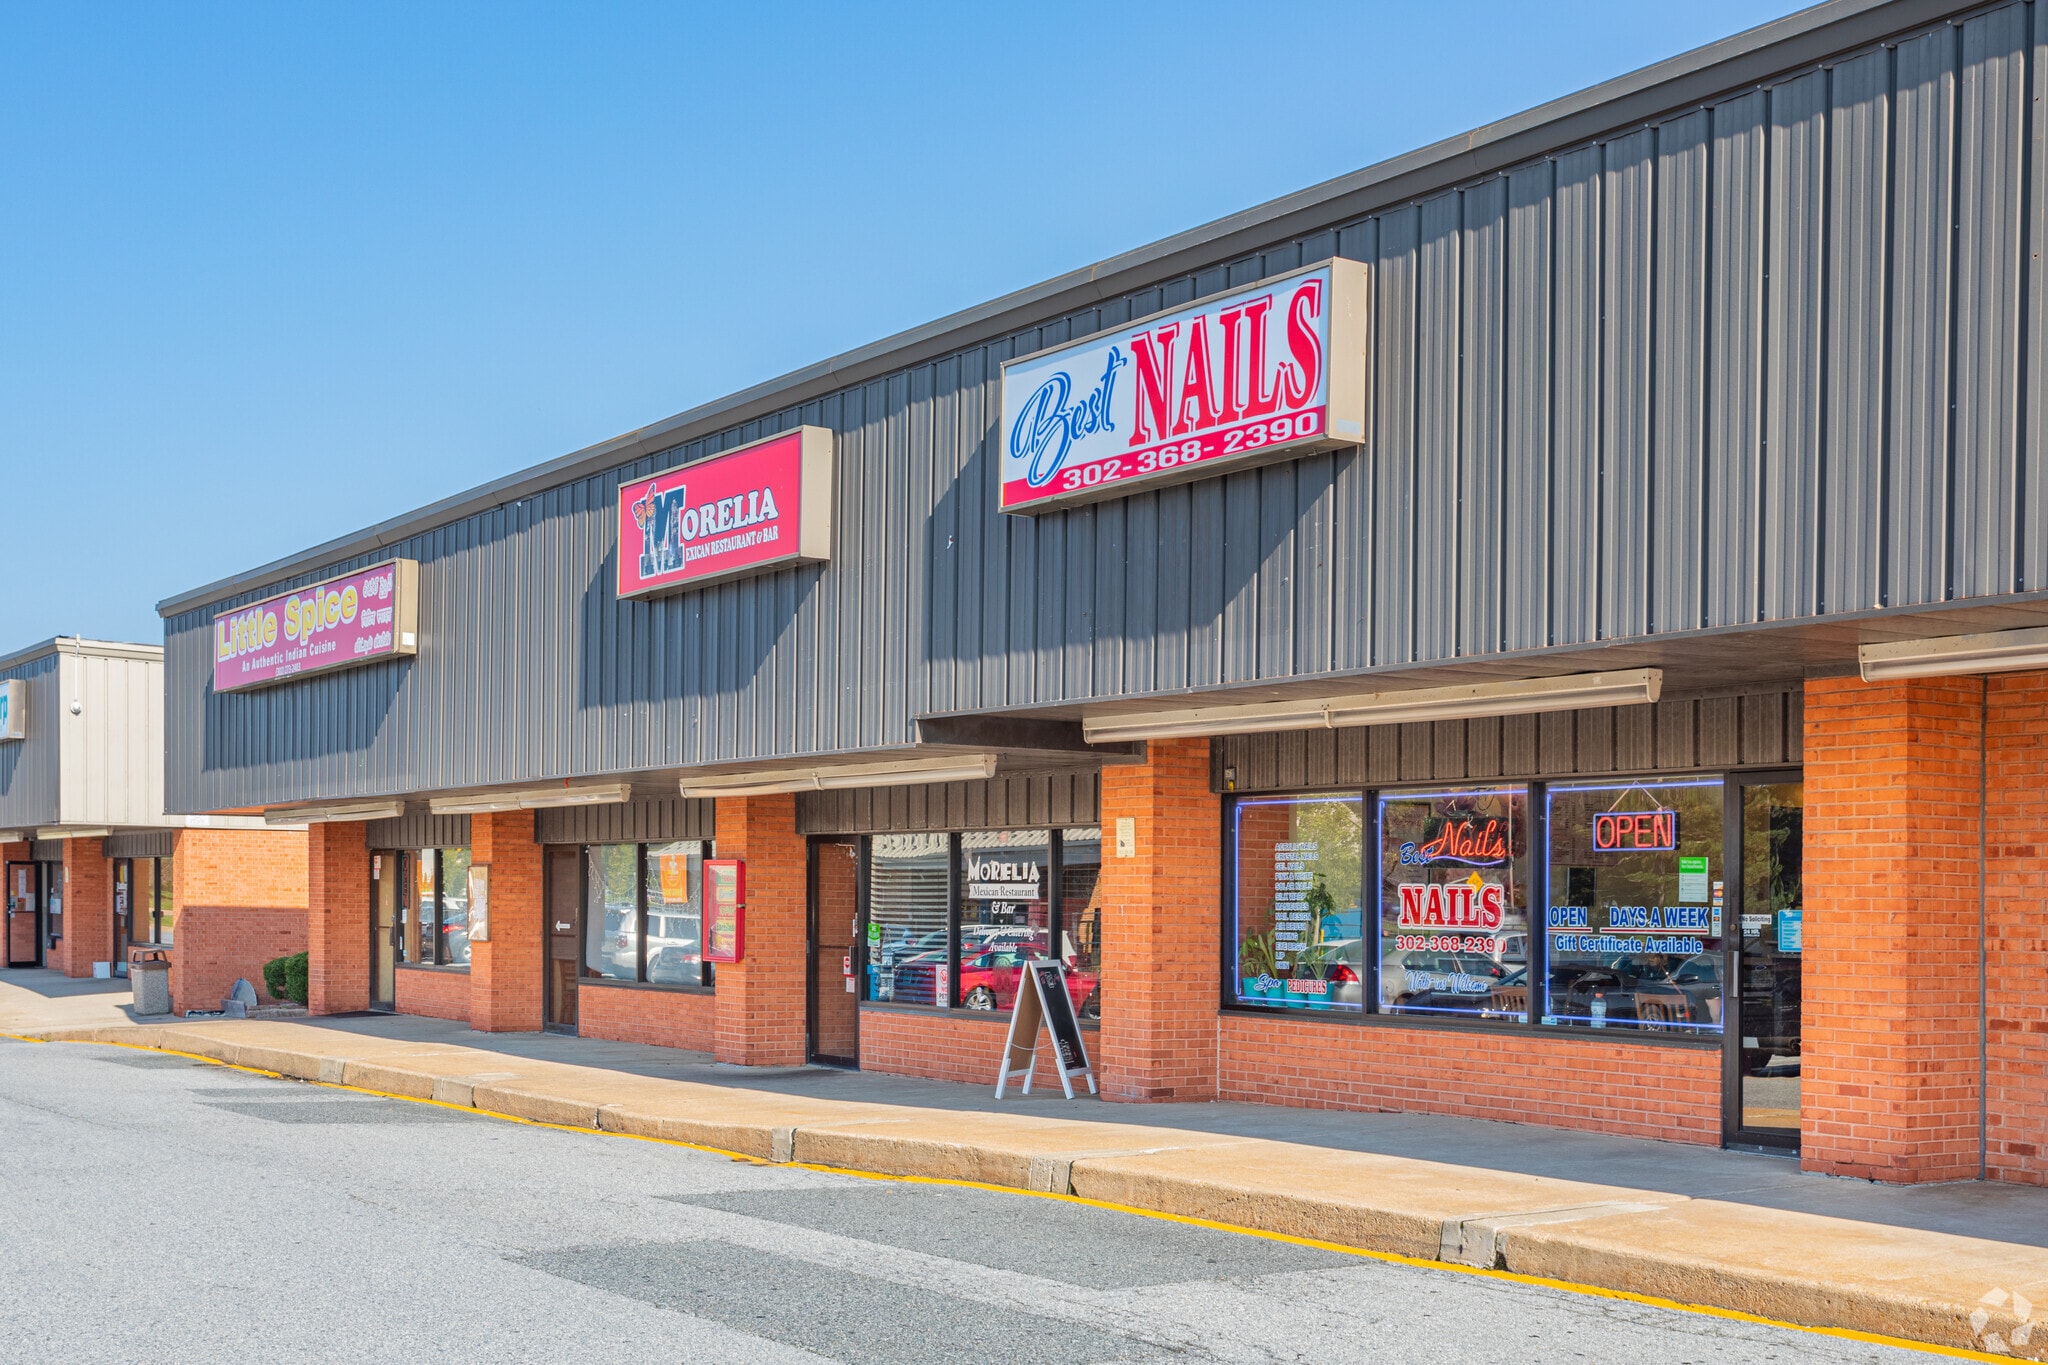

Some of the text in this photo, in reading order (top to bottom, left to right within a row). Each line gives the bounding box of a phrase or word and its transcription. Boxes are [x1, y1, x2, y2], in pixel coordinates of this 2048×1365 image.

[1010, 278, 1323, 488] Best NAILS
[710, 530, 757, 556] RESTAURANT
[763, 525, 779, 543] BAR
[217, 607, 278, 662] Little
[284, 585, 358, 646] Spice
[242, 660, 250, 673] An
[251, 651, 284, 670] Authentic
[285, 647, 307, 662] Indian
[309, 640, 337, 656] Cuisine
[1420, 819, 1506, 859] Nails
[1596, 814, 1672, 848] OPEN
[1300, 841, 1318, 850] NAILS
[1301, 851, 1319, 860] NAILS
[967, 855, 1040, 883] MORELIA
[1287, 861, 1305, 870] NAILS
[973, 885, 1034, 897] Mexican Restaurant
[1295, 881, 1313, 890] NAILS
[991, 901, 1016, 914] & Bar
[1398, 883, 1504, 933] NAILS
[1550, 906, 1587, 927] OPEN
[1610, 906, 1647, 928] DAYS
[1650, 907, 1661, 927] A
[1664, 907, 1709, 928] WEEK
[1286, 922, 1306, 931] BRUSH
[1555, 935, 1703, 954] Gift Certificate Available
[1254, 973, 1327, 995] Spa PEDICURES
